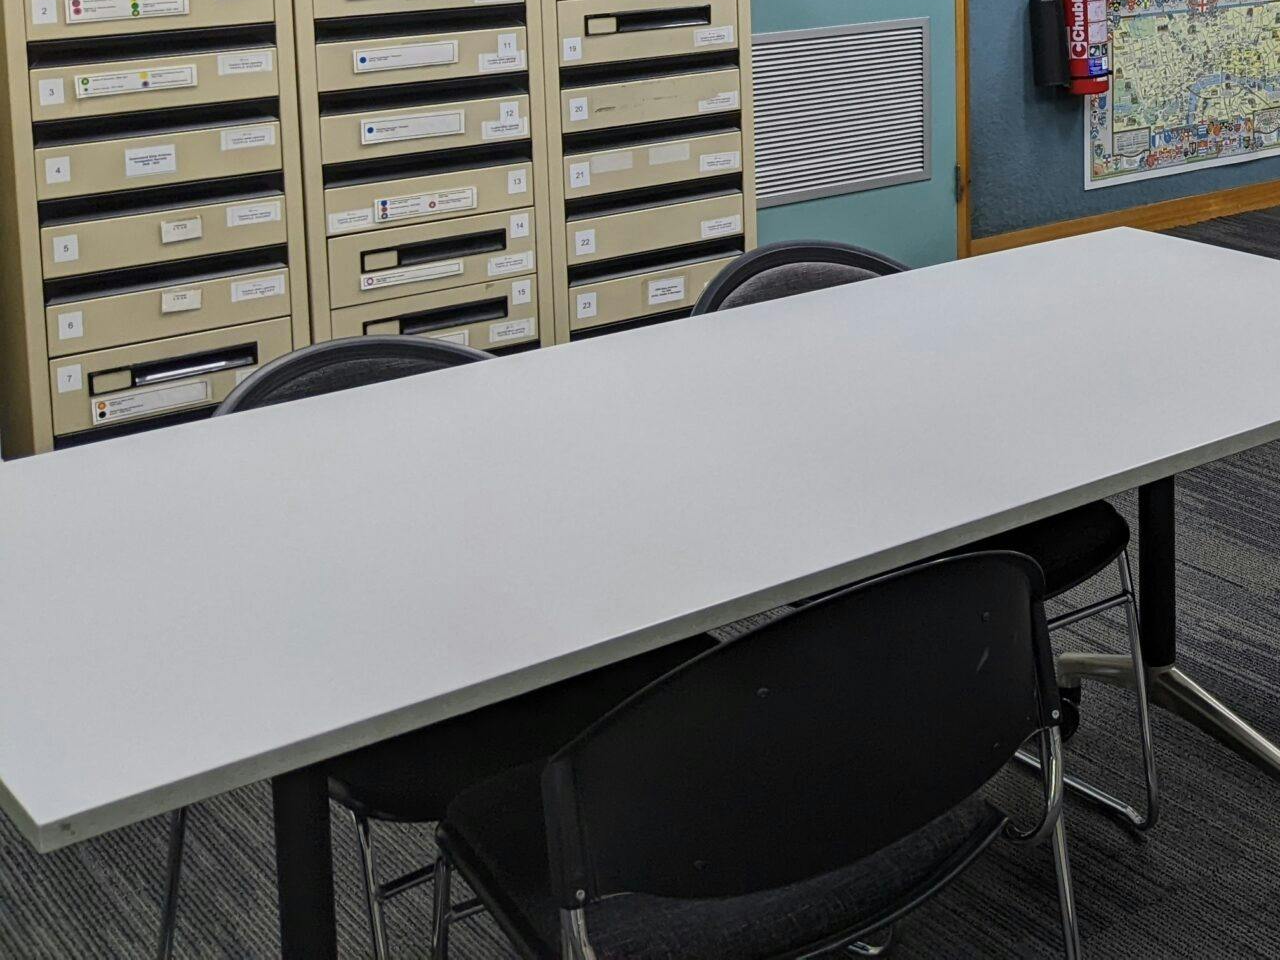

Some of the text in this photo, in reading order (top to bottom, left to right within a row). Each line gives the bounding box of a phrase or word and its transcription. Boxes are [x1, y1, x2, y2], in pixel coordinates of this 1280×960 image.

[41, 7, 48, 15] 2
[568, 44, 577, 53] 19
[49, 88, 54, 97] 3
[574, 105, 583, 113] 20
[55, 166, 61, 174] 4
[576, 171, 584, 180] 21
[516, 222, 524, 230] 14
[580, 238, 590, 246] 22
[63, 244, 69, 252] 5
[518, 288, 526, 296] 15
[582, 302, 592, 310] 23
[68, 322, 74, 330] 6
[66, 374, 72, 382] 7
